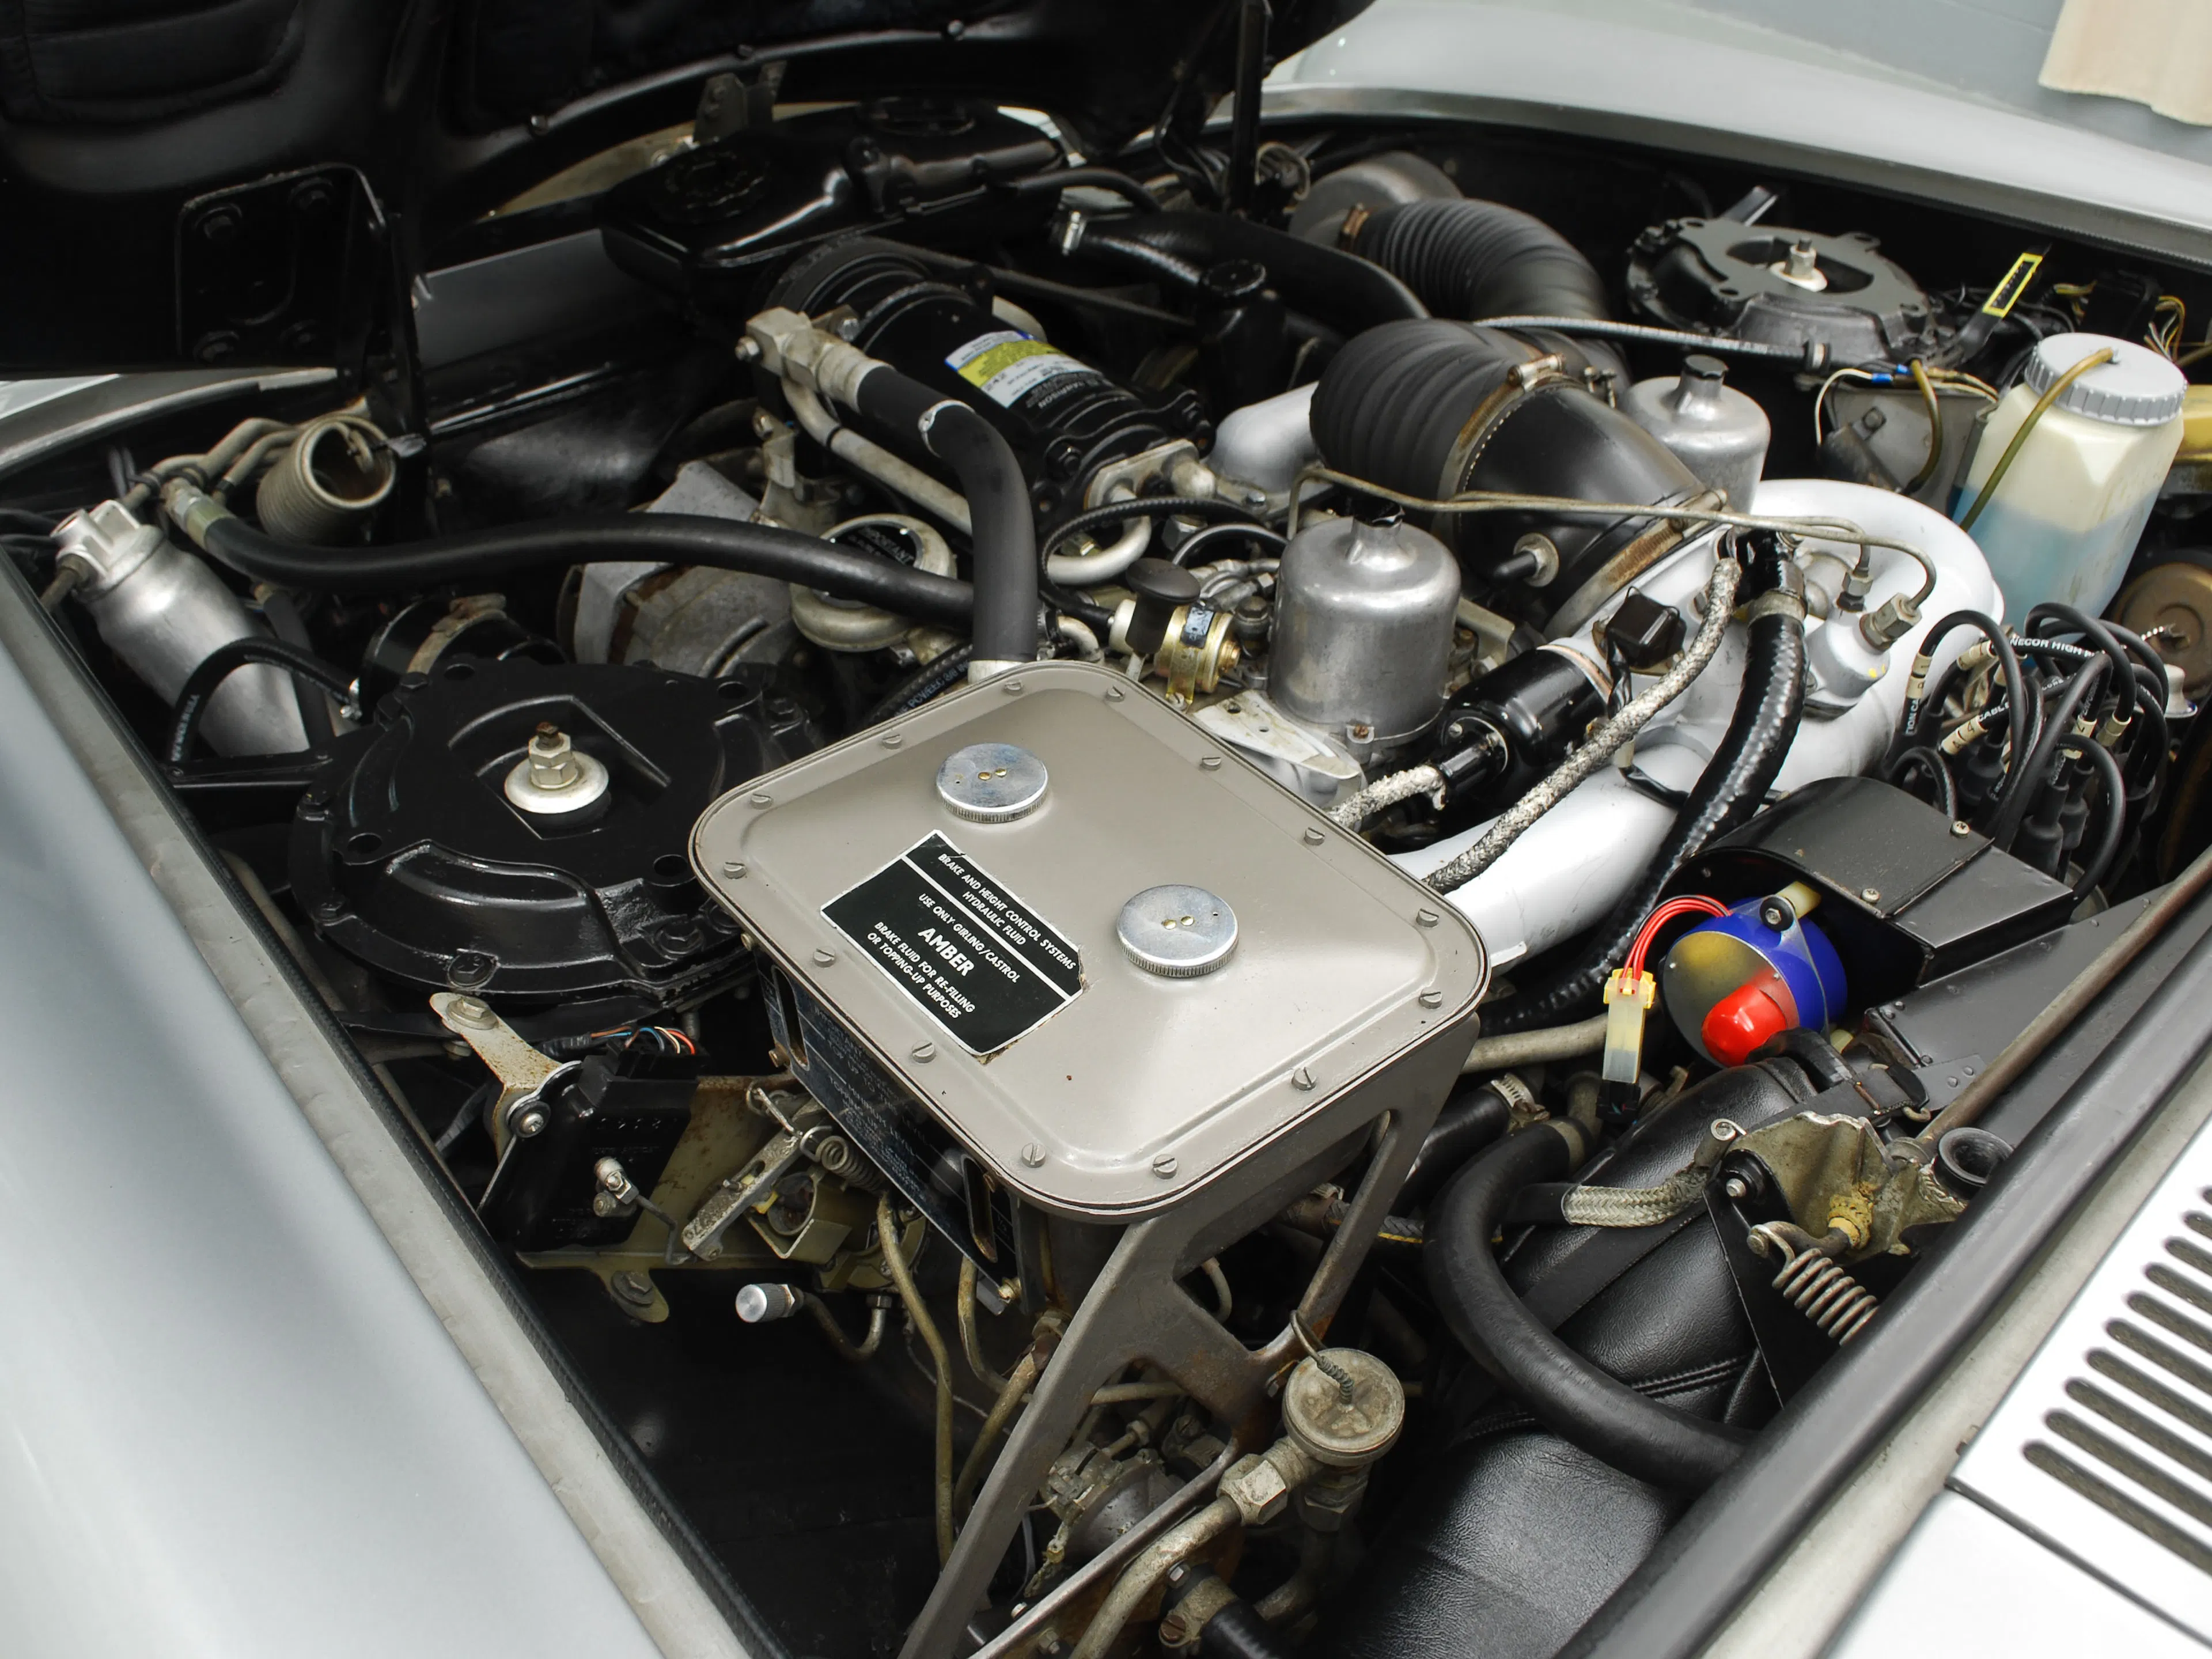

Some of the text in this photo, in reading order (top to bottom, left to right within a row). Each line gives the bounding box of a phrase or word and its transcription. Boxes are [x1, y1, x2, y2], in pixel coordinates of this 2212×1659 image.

[2051, 641, 2082, 655] HIGH
[918, 893, 1020, 983] USE ONLY GIRLING/CASTROL
[918, 927, 975, 976] AMBER
[938, 853, 1077, 970] BRAKE AND HEIGHT CONTROL SYSTEMS
[963, 891, 1025, 945] HYDRAULIC FLUID
[867, 933, 961, 1019] OR TOPPING-UP PURPOSES
[874, 922, 975, 1013] BRAKE FLUID FOR RE-FILLING
